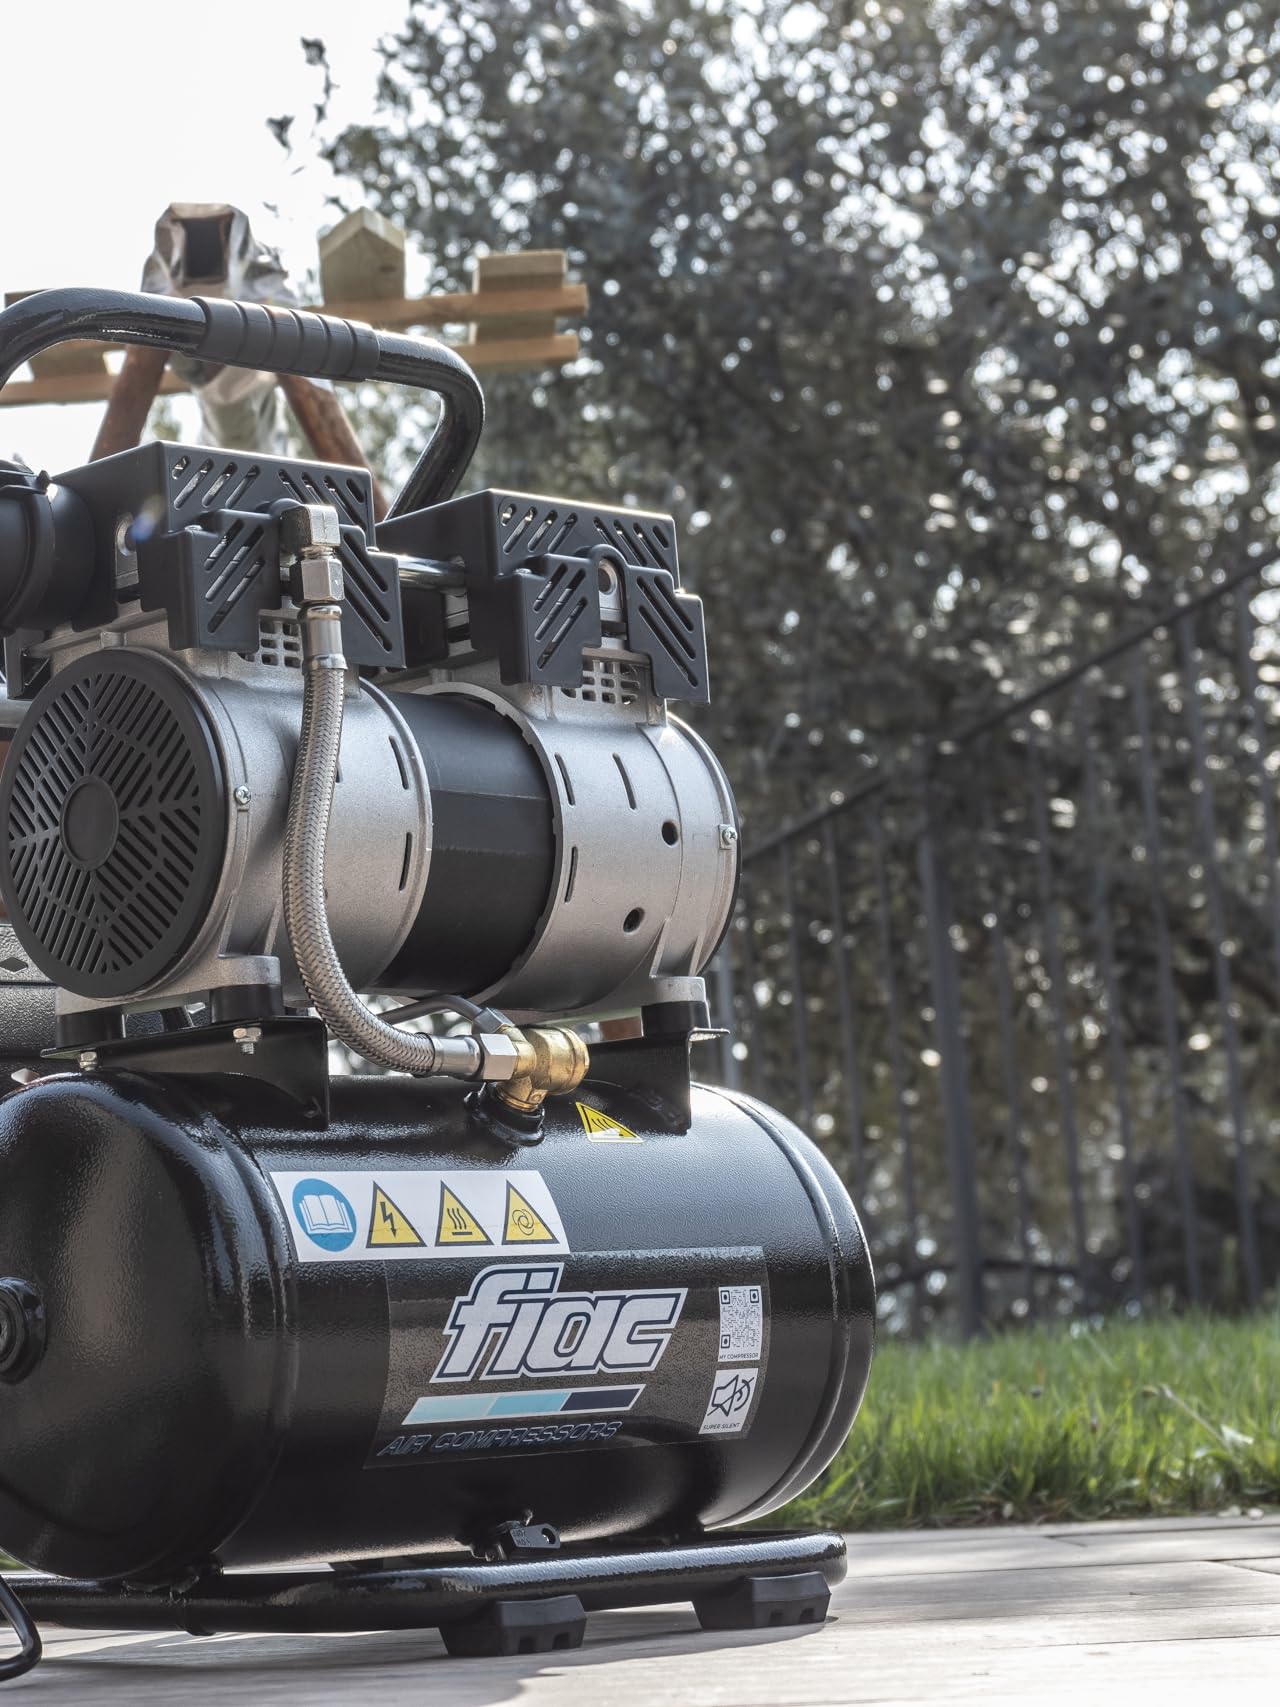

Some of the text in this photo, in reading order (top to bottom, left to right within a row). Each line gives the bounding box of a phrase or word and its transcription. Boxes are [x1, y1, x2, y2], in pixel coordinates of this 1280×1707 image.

[429, 1262, 688, 1383] fiac
[727, 1352, 759, 1360] COMPRESSOR
[377, 1421, 623, 1456] AIR COMPRESSORS
